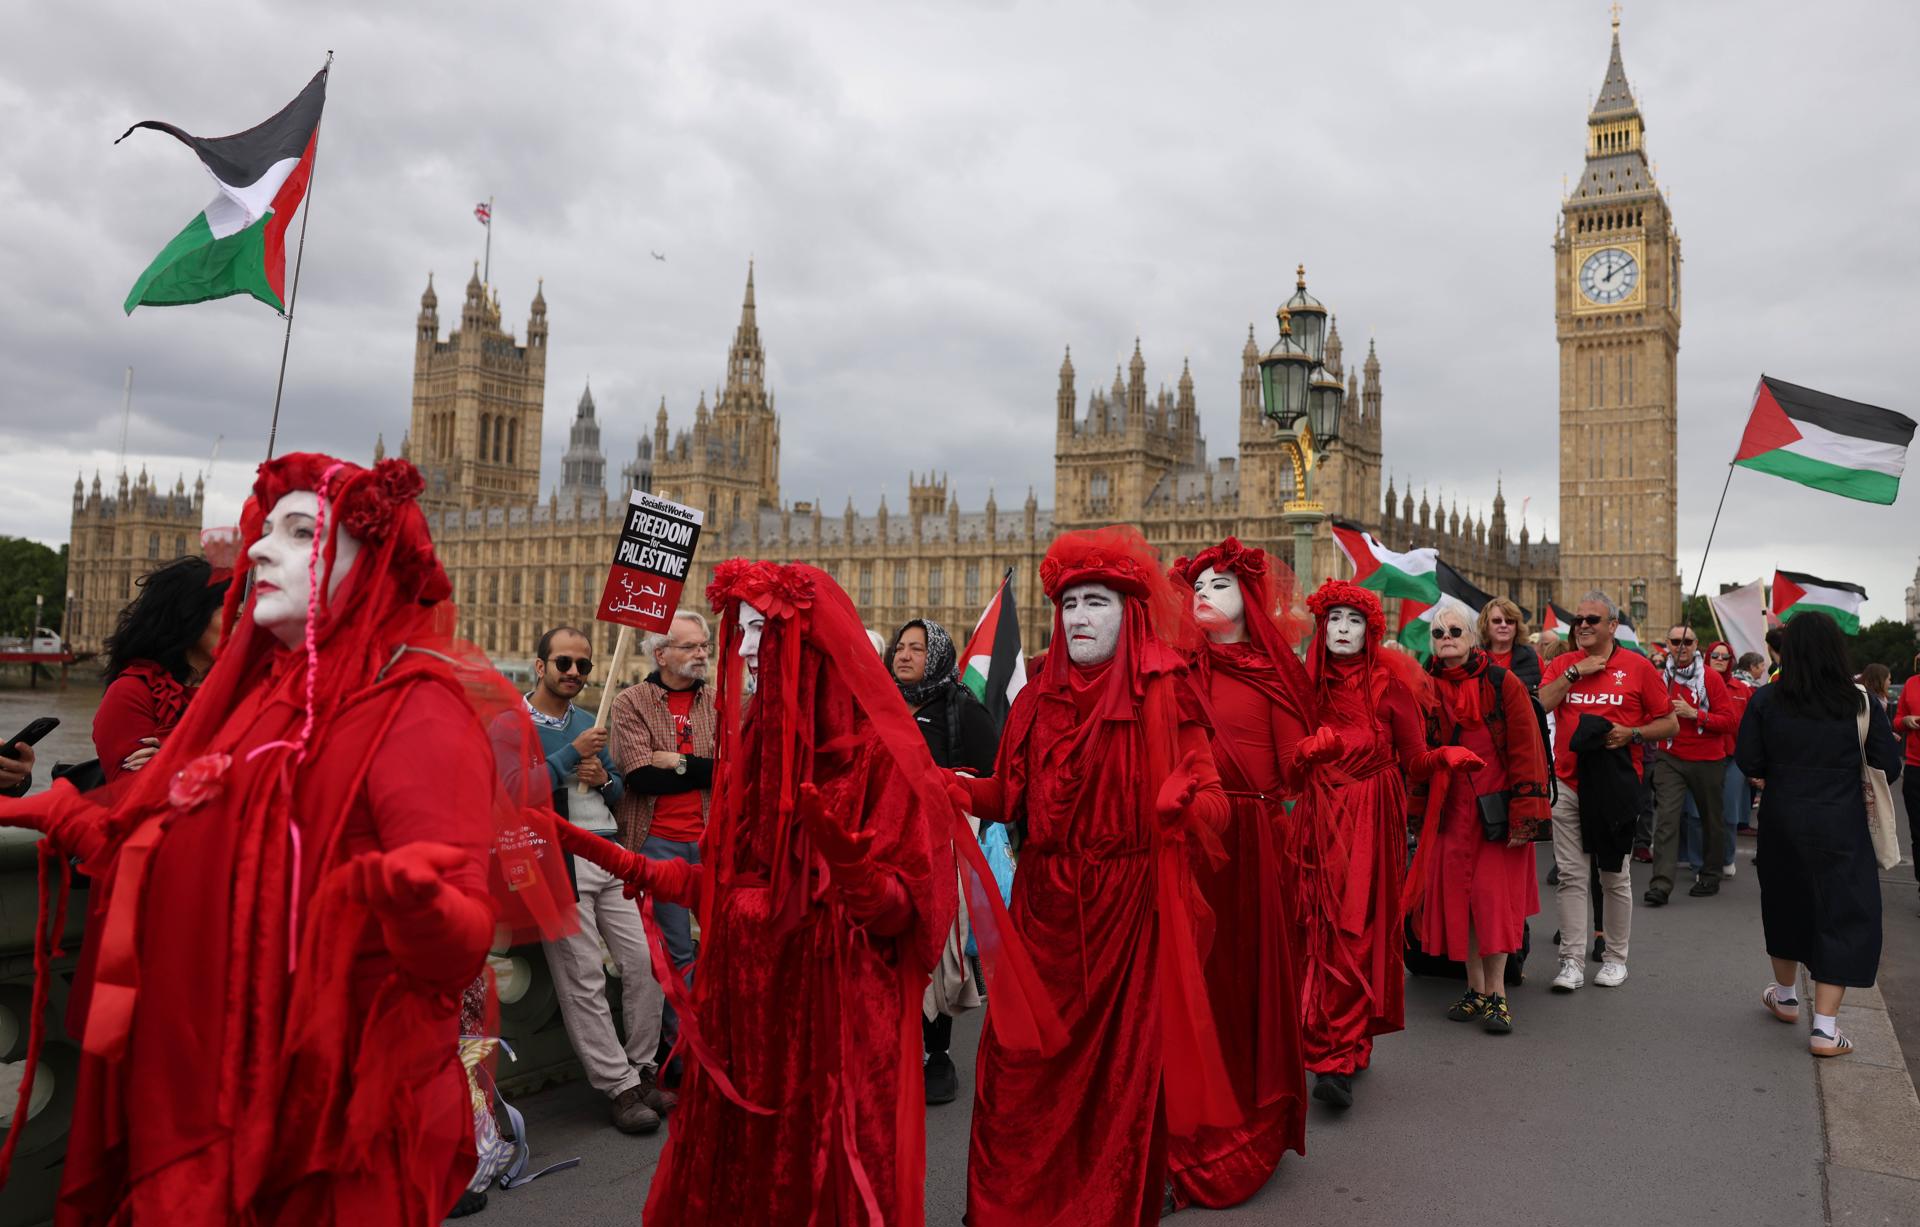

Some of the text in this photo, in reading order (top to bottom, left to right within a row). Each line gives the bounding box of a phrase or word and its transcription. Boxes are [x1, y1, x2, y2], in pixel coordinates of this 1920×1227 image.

[630, 511, 693, 547] FREEDOM
[650, 537, 661, 548] for
[618, 541, 687, 577] PALESTINE
[620, 573, 667, 598] الحرية
[608, 595, 667, 619] لفلسطين
[1566, 693, 1623, 706] ISUZU
